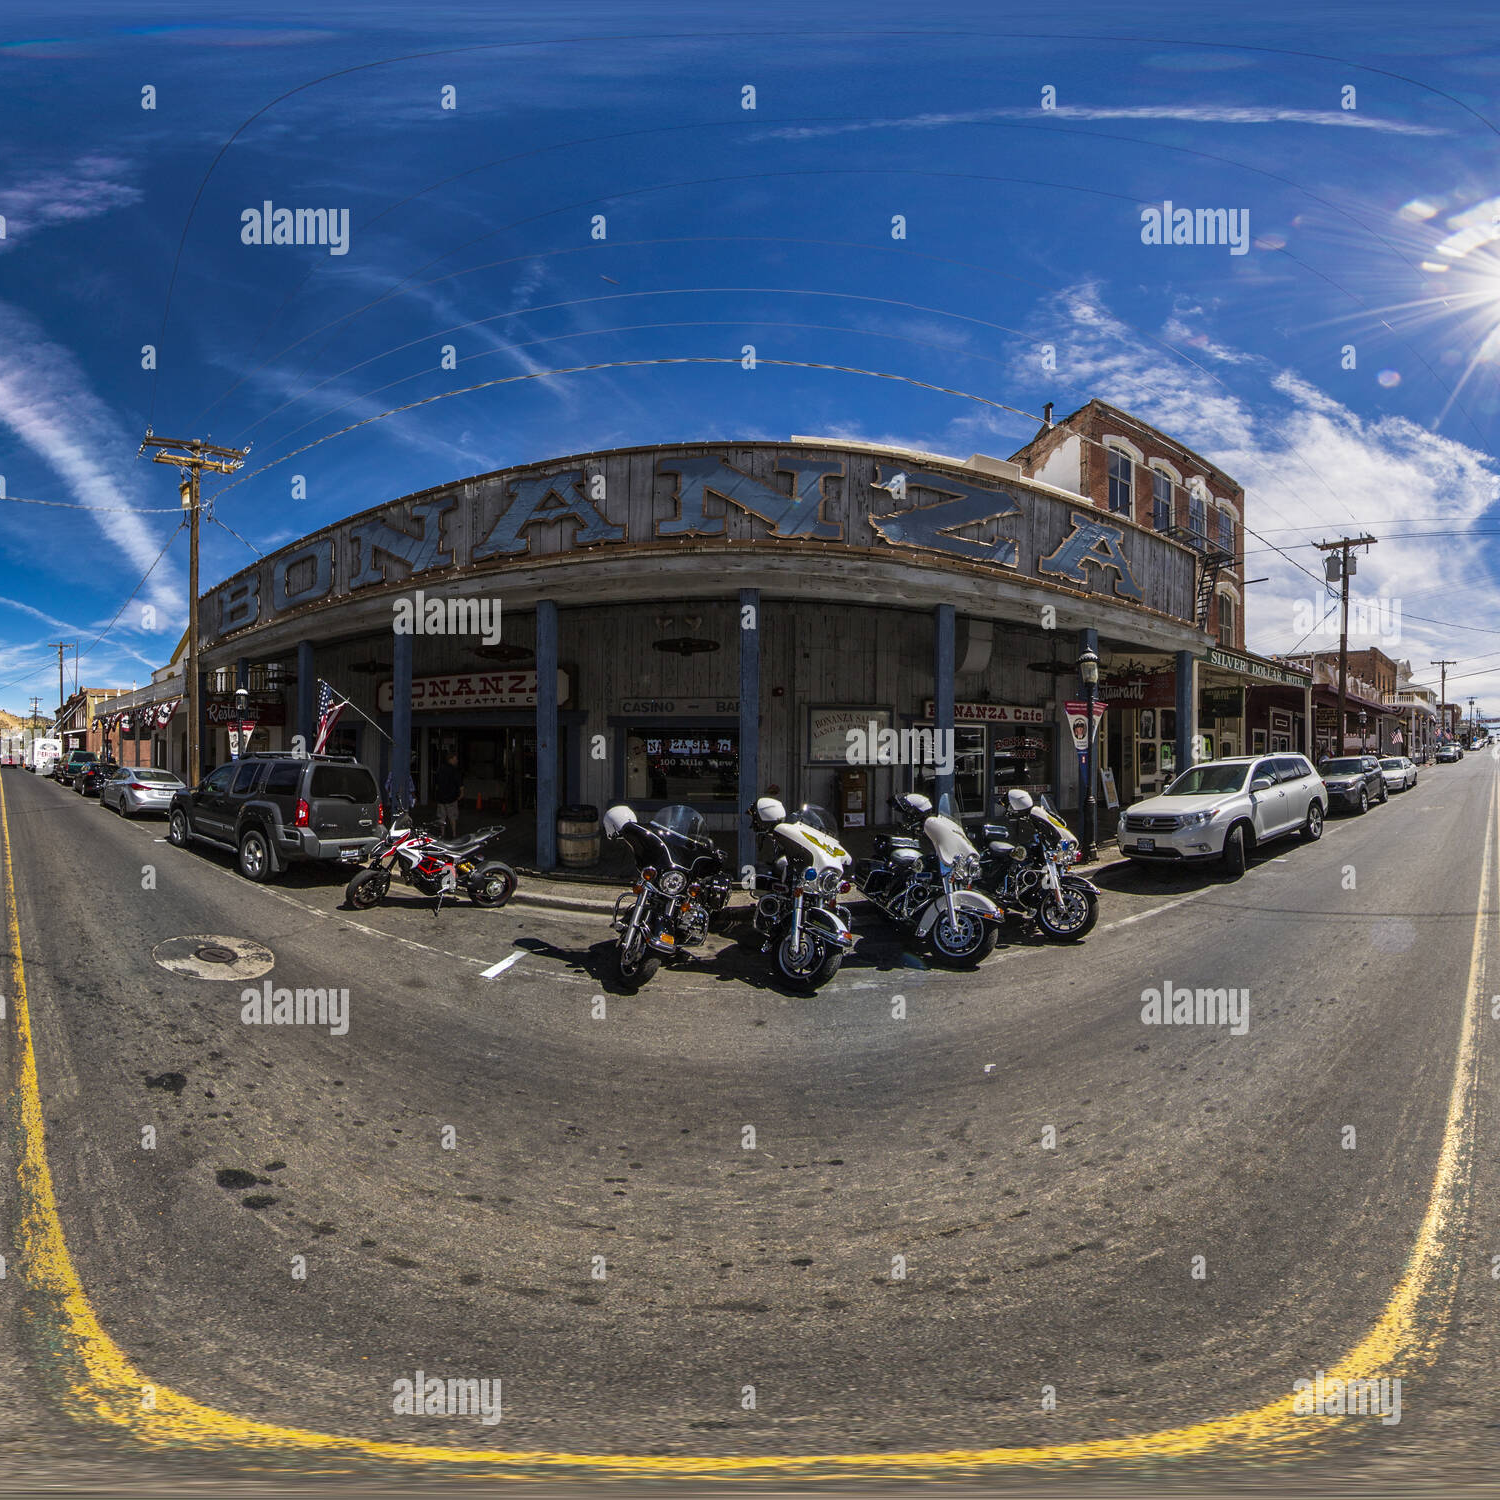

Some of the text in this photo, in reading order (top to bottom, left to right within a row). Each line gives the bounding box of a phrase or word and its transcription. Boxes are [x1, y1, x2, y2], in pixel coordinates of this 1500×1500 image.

[217, 455, 1146, 636] BONANZA
[1211, 650, 1306, 687] SILVER DOLLAR HOTEL
[388, 675, 538, 701] ONANZ
[464, 697, 516, 705] CATTLE
[622, 701, 676, 713] CASINO
[815, 712, 853, 729] BONANZA
[928, 703, 1042, 722] BNANZA Cafe
[812, 725, 836, 739] LAND
[660, 758, 733, 767] 100 Mile View
